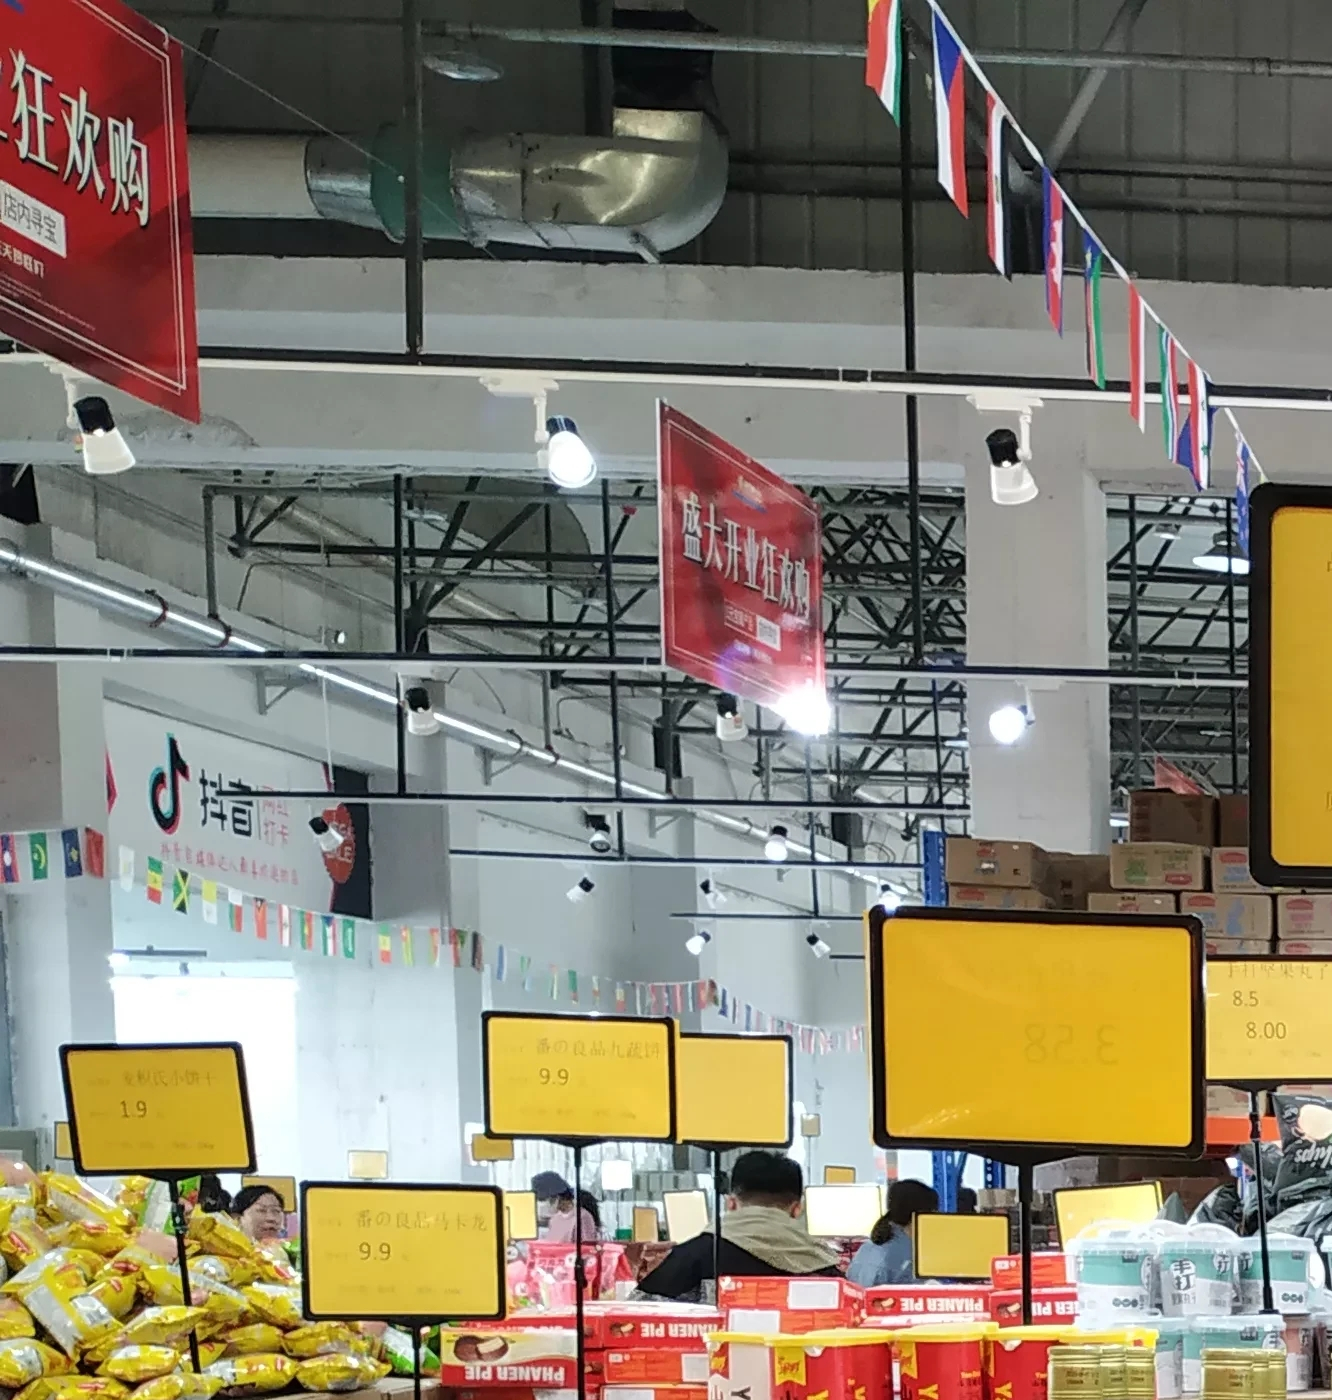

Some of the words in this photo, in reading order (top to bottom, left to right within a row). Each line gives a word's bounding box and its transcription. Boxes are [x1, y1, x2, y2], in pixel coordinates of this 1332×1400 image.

[0, 48, 149, 227] 狂欢购
[680, 490, 812, 622] 盛大开业狂欢购
[1232, 989, 1260, 1008] 8.5
[1245, 1020, 1287, 1040] 8.00
[538, 1067, 570, 1087] 9.9
[120, 1100, 149, 1118] 1.9
[358, 1241, 392, 1261] 9.9
[1170, 1259, 1196, 1291] 手打
[900, 1297, 924, 1312] PIE
[926, 1297, 984, 1312] PHANER
[640, 1318, 666, 1335] PIE
[464, 1365, 494, 1384] PIE
[498, 1366, 566, 1386] PHANER
